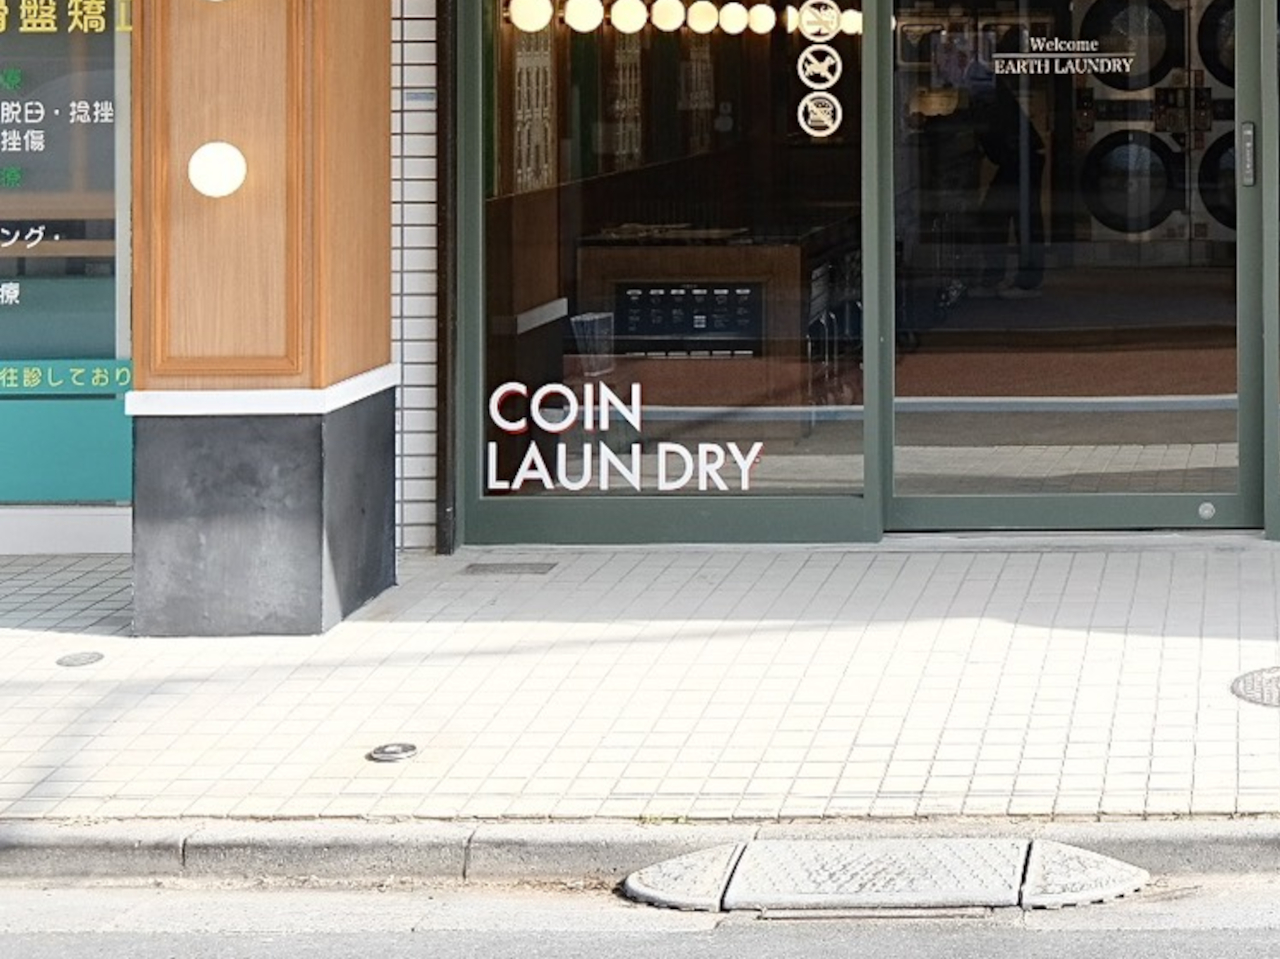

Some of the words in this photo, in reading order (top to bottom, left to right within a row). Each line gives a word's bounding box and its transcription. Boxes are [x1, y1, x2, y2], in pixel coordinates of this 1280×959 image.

[1030, 37, 1099, 51] Welcome
[995, 59, 1050, 74] EARTH
[1054, 58, 1134, 74] LAUNDRY
[0, 130, 45, 152] 挫傷
[0, 367, 131, 388] 往診しており
[489, 381, 642, 433] COIN
[487, 440, 764, 492] LAUNDRY
